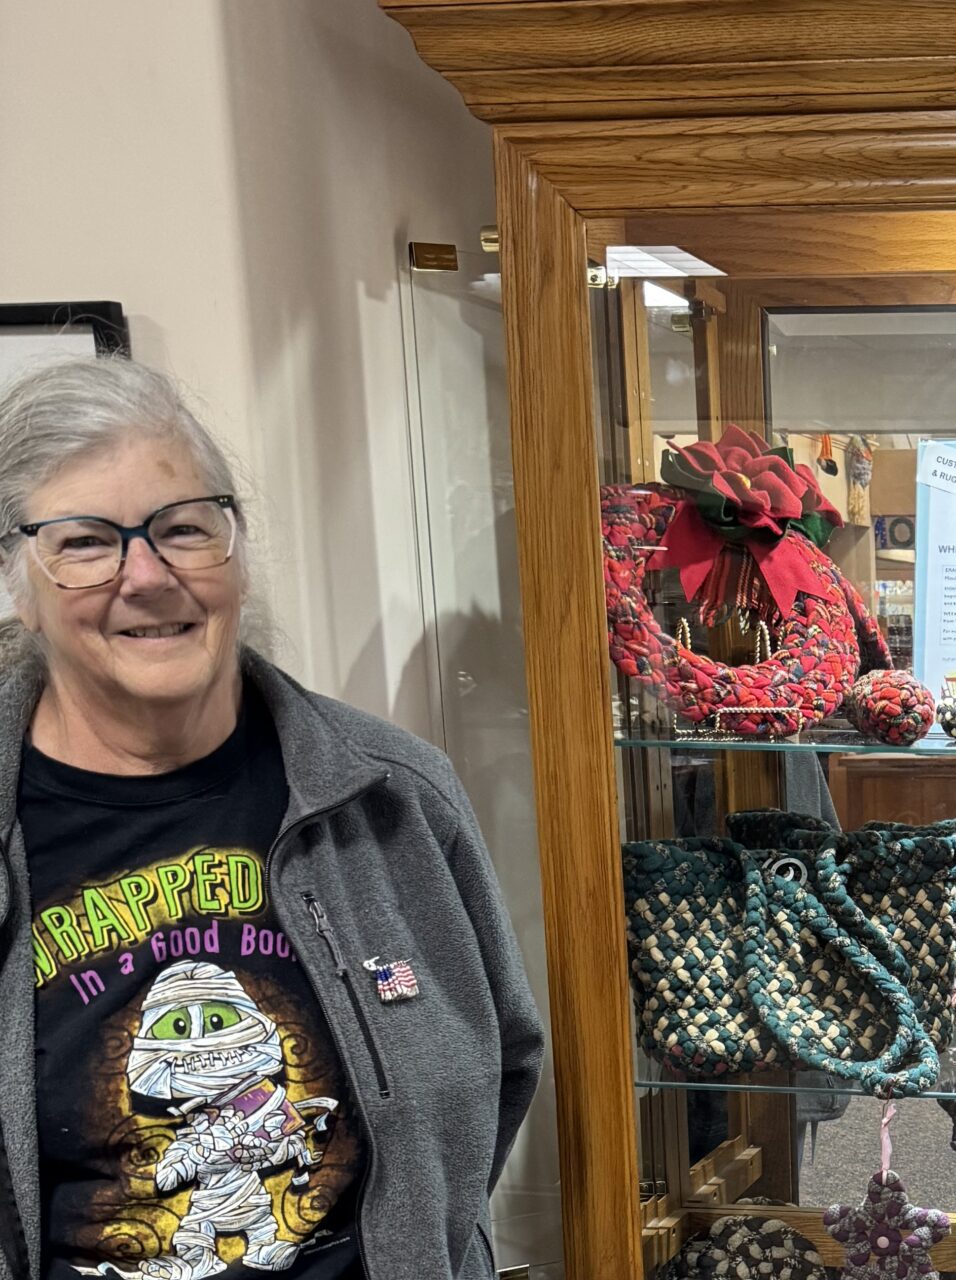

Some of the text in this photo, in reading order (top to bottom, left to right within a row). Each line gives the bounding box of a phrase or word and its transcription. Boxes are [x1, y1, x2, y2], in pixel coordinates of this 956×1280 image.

[931, 469, 938, 477] &
[70, 969, 106, 1005] In
[118, 952, 135, 976] a
[241, 924, 298, 962] Boo
